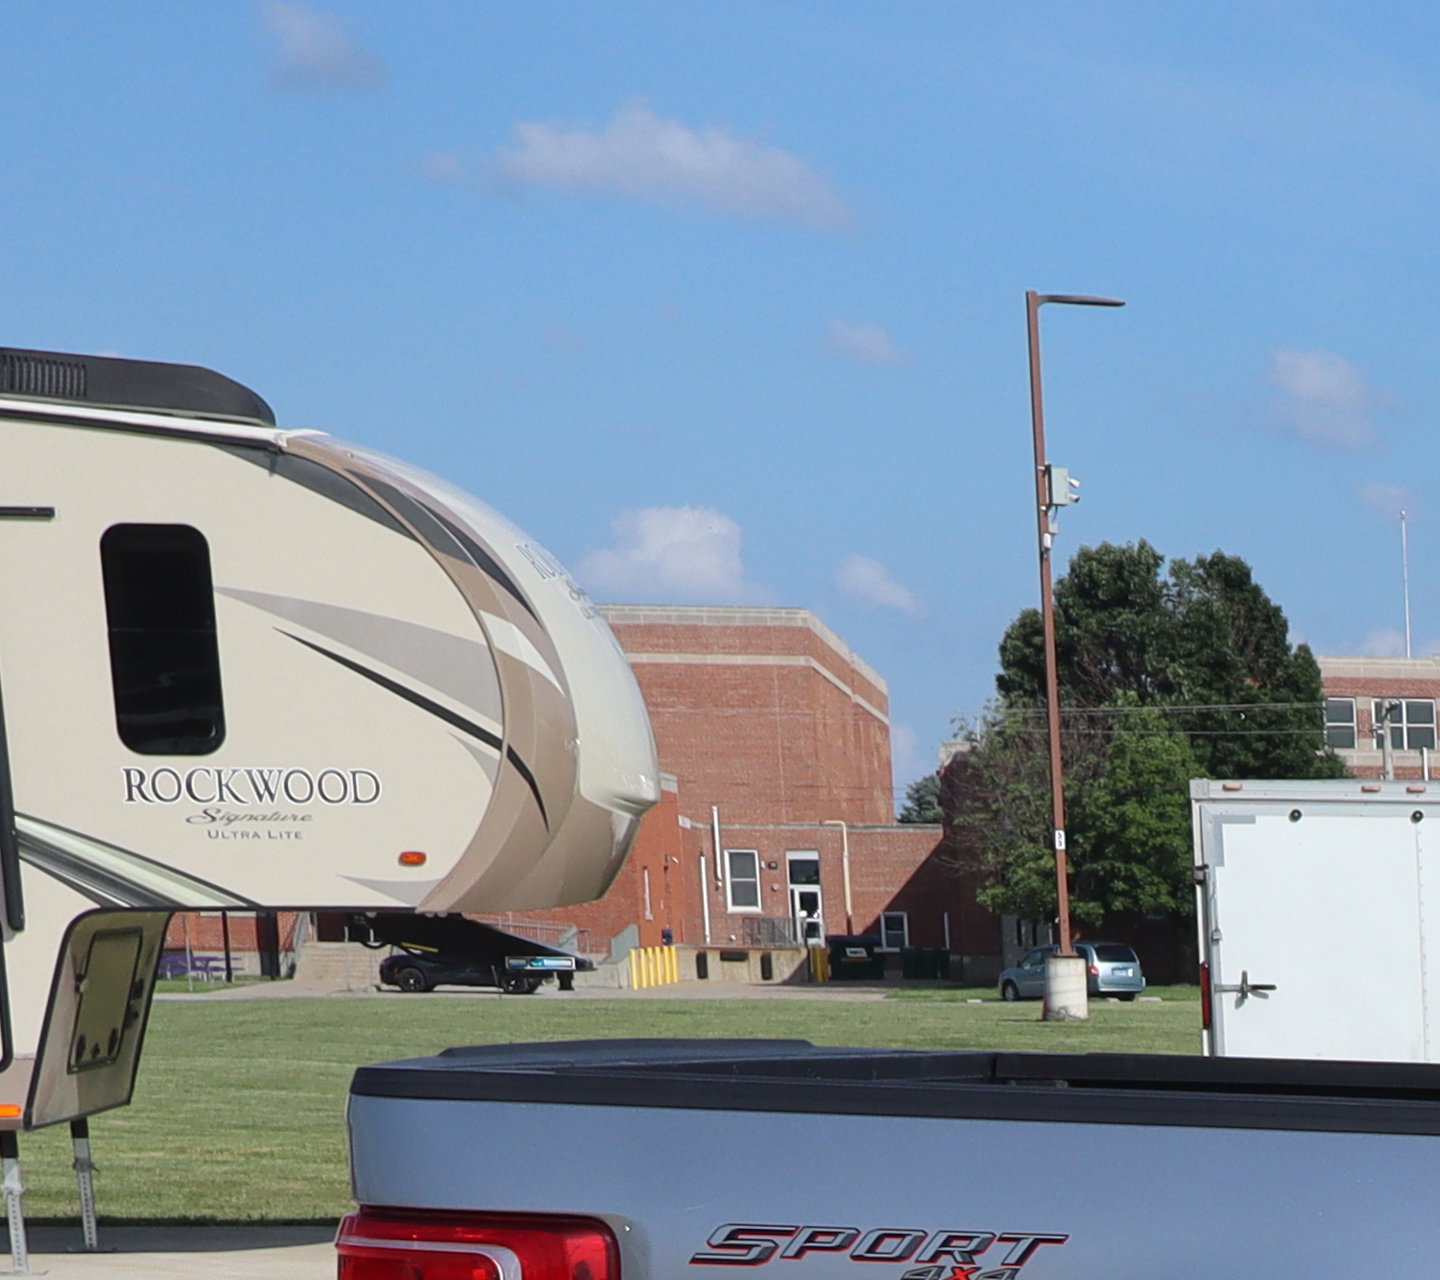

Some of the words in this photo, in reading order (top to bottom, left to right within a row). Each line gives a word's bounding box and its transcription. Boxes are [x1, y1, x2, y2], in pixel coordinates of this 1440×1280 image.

[122, 767, 382, 805] ROCKWOOD
[185, 808, 313, 826] Signature
[207, 829, 261, 840] ULTRA
[267, 829, 303, 840] LITE
[689, 1223, 1070, 1267] SPORT
